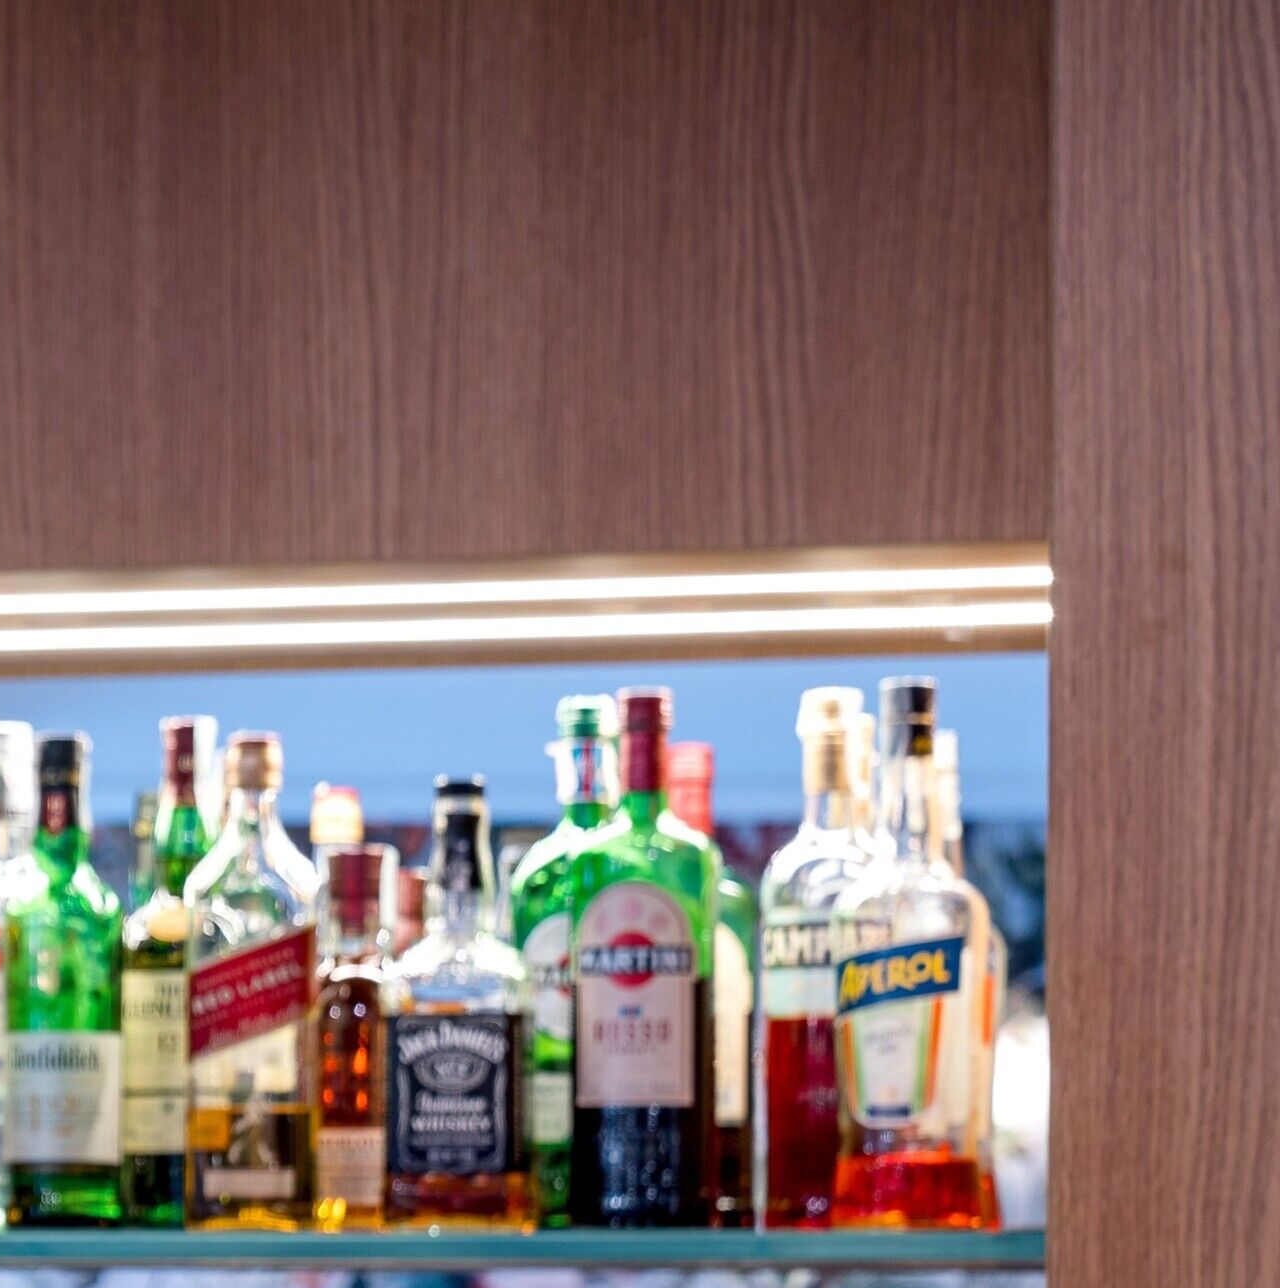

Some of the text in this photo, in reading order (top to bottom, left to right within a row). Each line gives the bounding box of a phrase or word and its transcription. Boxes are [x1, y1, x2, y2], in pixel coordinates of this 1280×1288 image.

[582, 947, 690, 974] MARTINI
[840, 949, 951, 1007] APEROL
[397, 1028, 439, 1064] JACK
